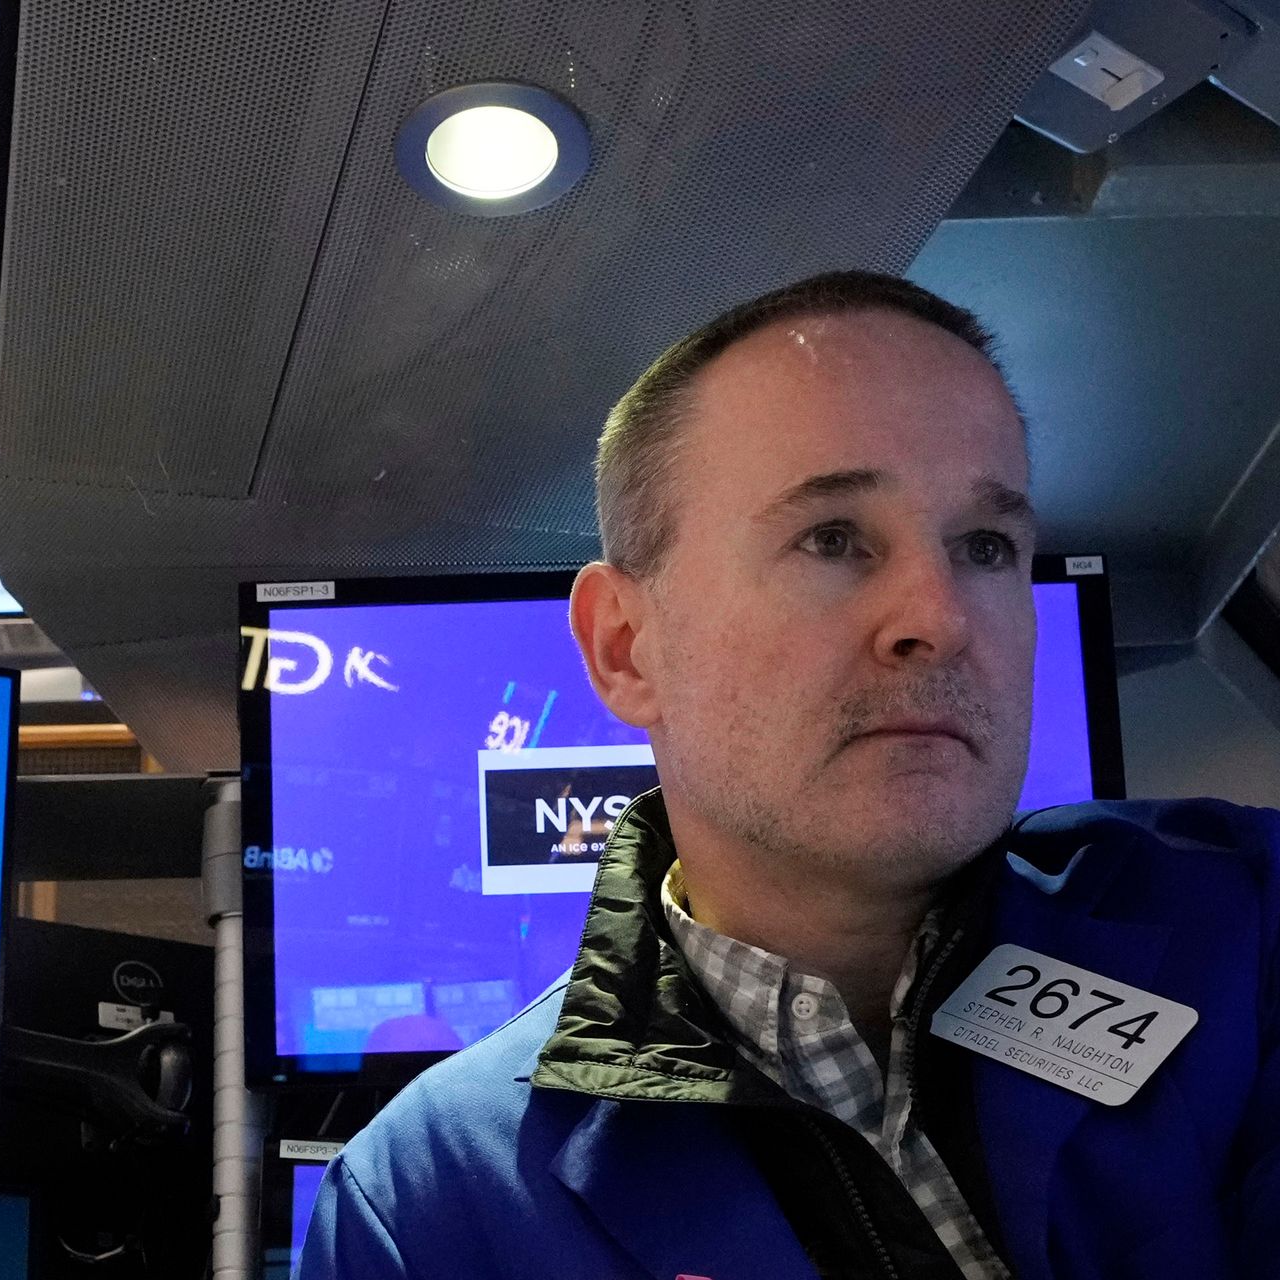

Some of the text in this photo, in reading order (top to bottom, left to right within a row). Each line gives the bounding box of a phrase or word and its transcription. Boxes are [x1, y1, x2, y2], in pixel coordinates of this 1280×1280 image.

[551, 843, 566, 852] AN
[963, 1001, 1133, 1074] STEPHEN R. NAUGHTON
[984, 964, 1159, 1050] 2674
[953, 1025, 1103, 1093] CITADEL SECURITIES LLC
